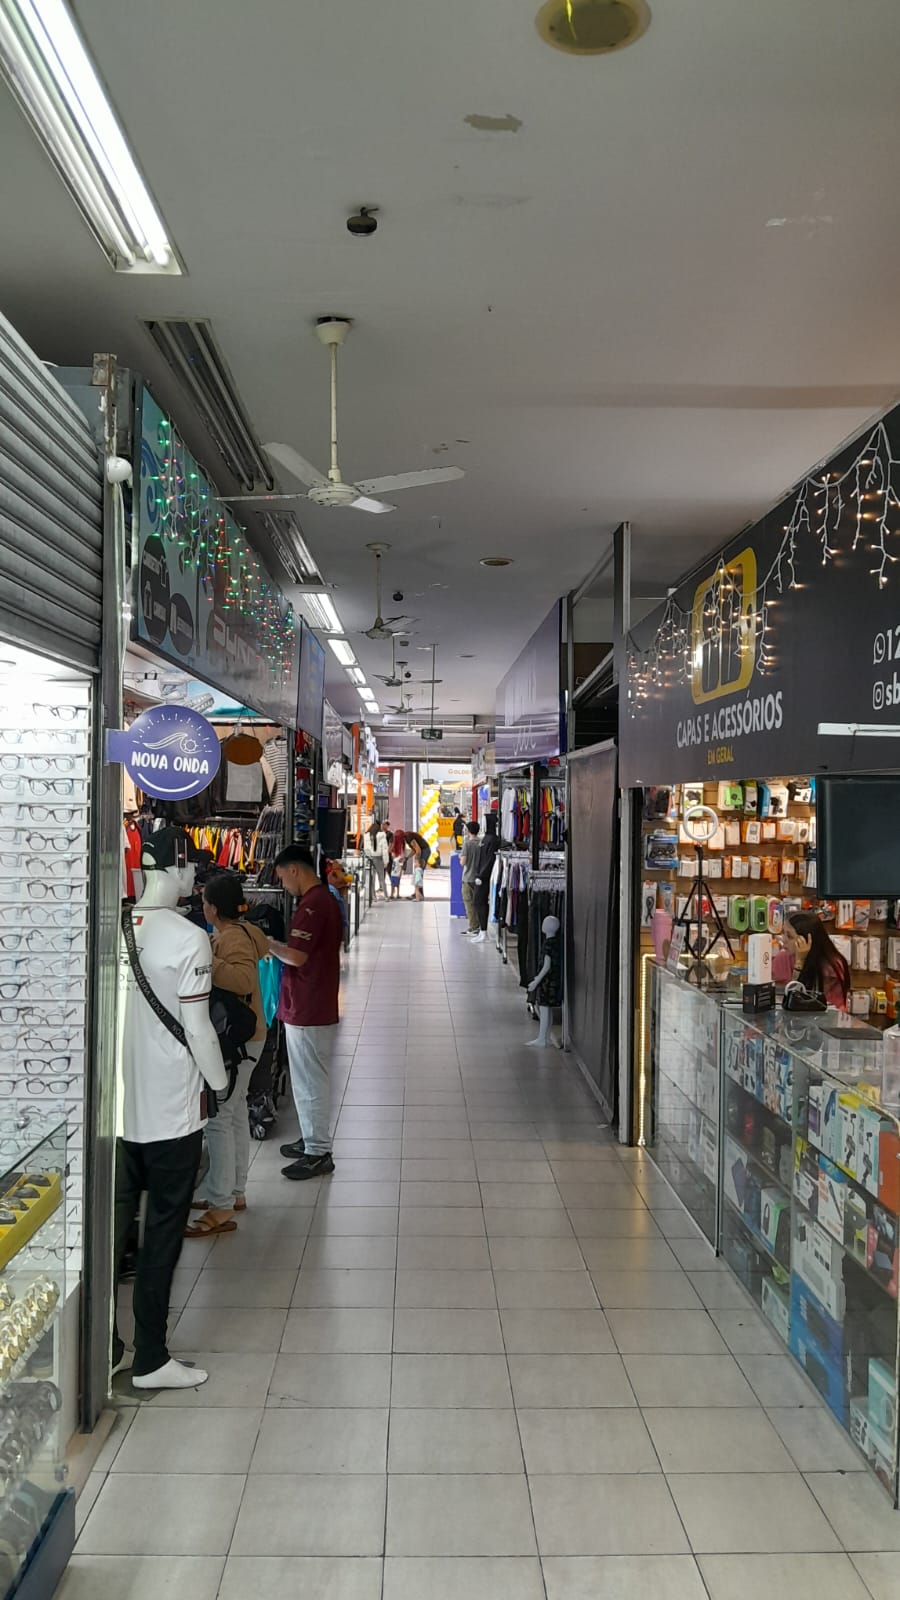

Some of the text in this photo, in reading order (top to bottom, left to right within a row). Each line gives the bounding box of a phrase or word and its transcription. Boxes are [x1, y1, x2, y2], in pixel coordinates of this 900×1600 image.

[676, 690, 783, 748] CAPAS E ACESSÓRIOS
[131, 751, 209, 774] NOVA ONDA
[707, 745, 734, 765] EM GERAL
[149, 996, 167, 1018] LOUIS
